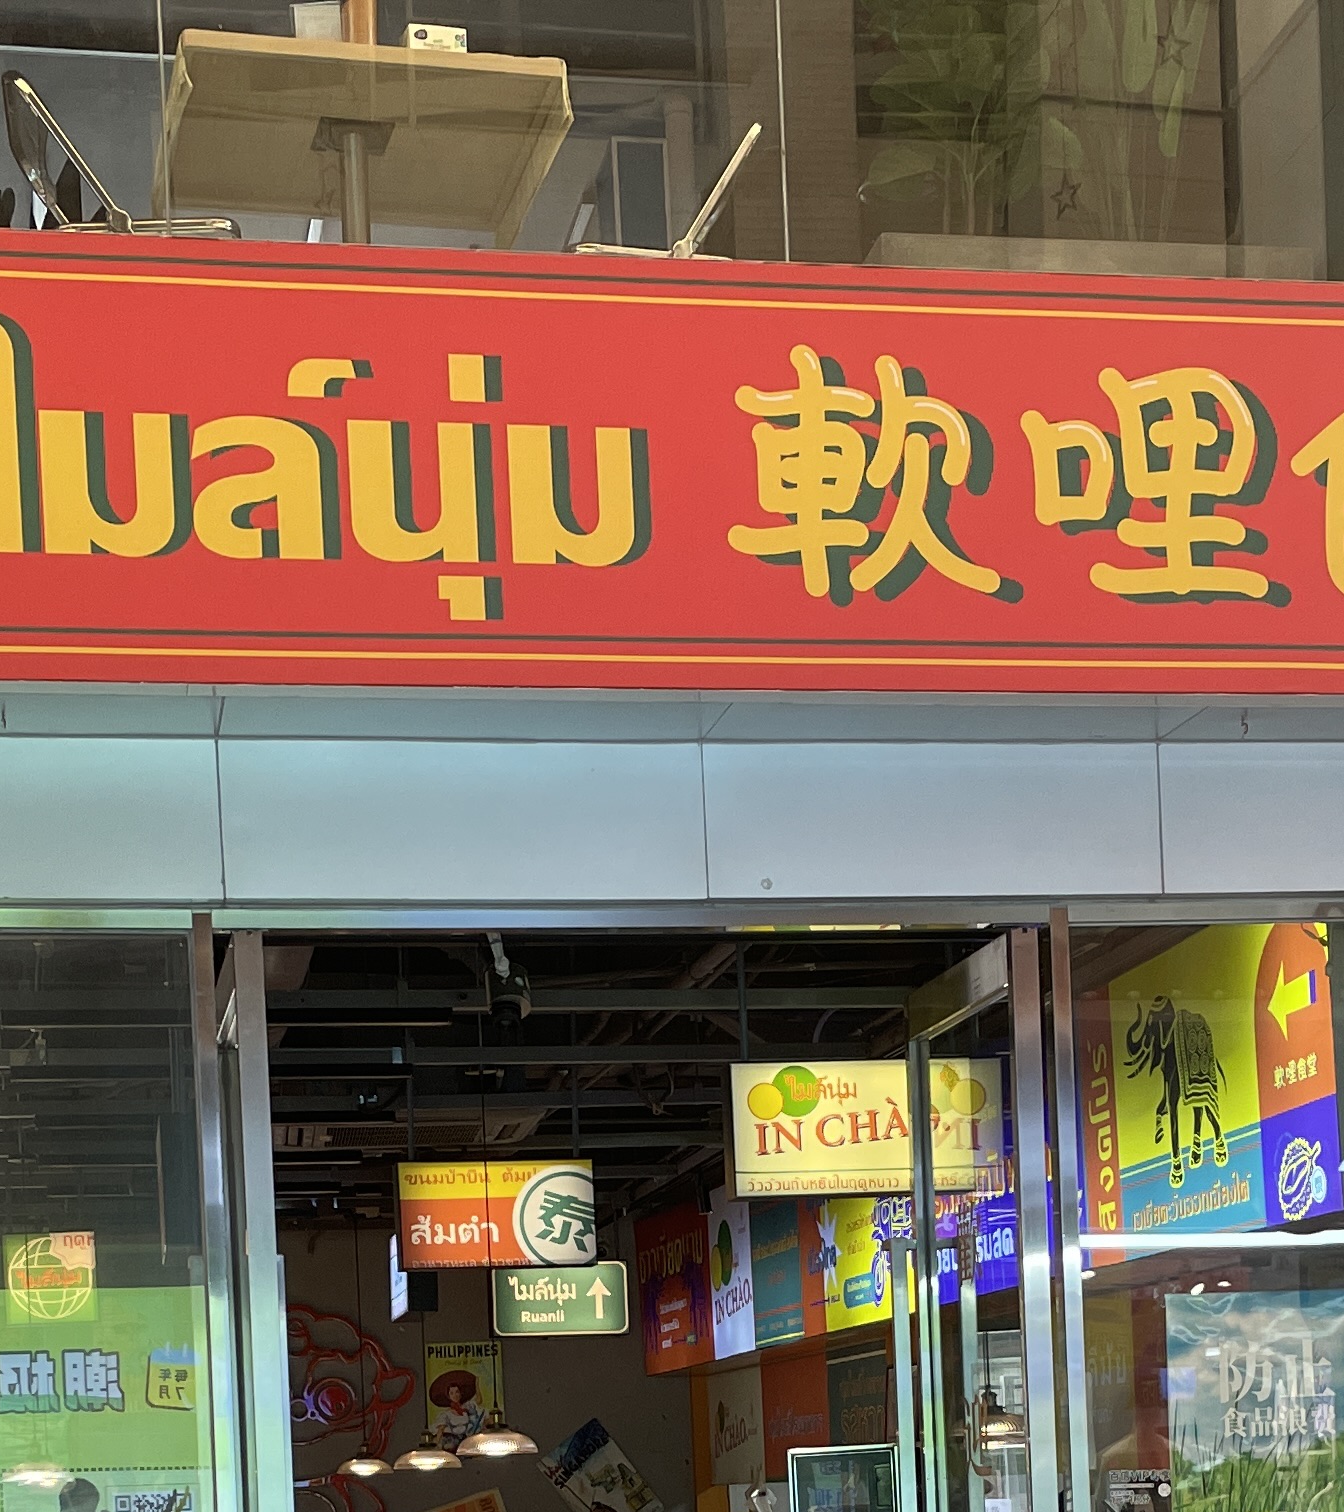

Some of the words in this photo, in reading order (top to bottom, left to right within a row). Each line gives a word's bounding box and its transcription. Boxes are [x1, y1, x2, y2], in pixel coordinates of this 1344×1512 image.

[754, 1119, 805, 1157] IN
[427, 1343, 499, 1359] PHILIPPINES
[1217, 1336, 1336, 1405] 防止
[1221, 1405, 1336, 1438] 食品浪费
